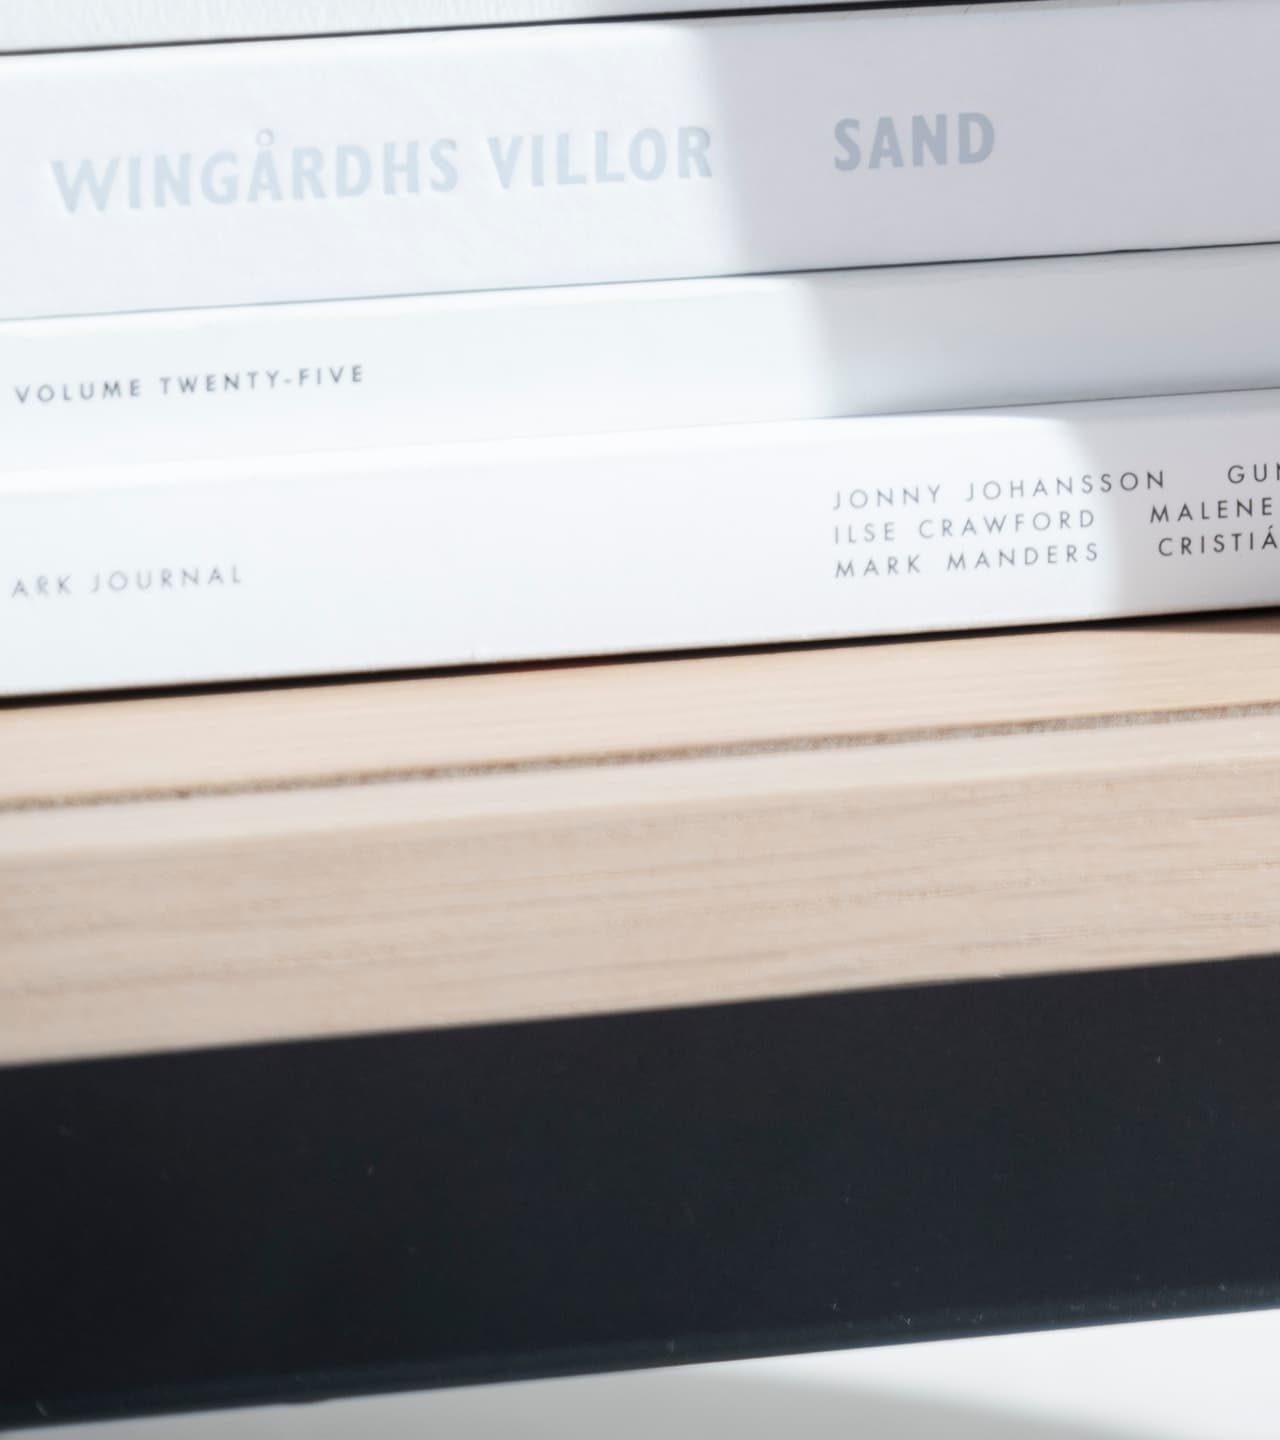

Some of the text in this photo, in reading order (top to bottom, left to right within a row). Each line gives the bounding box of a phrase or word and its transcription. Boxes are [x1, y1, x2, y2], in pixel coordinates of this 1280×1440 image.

[50, 111, 996, 215] WINGÅRDHS VILLOR SAND
[14, 364, 362, 404] VOLUME TWENTY-FIVE
[833, 484, 941, 511] JONNY
[967, 469, 1165, 502] JOHANSSON
[833, 521, 895, 545] ILSE
[917, 508, 1097, 540] CRAWFORD
[1149, 496, 1272, 523] MALENE
[835, 555, 920, 578] MARK
[946, 541, 1099, 571] MANDERS
[11, 565, 241, 597] ARK JOURNAL
